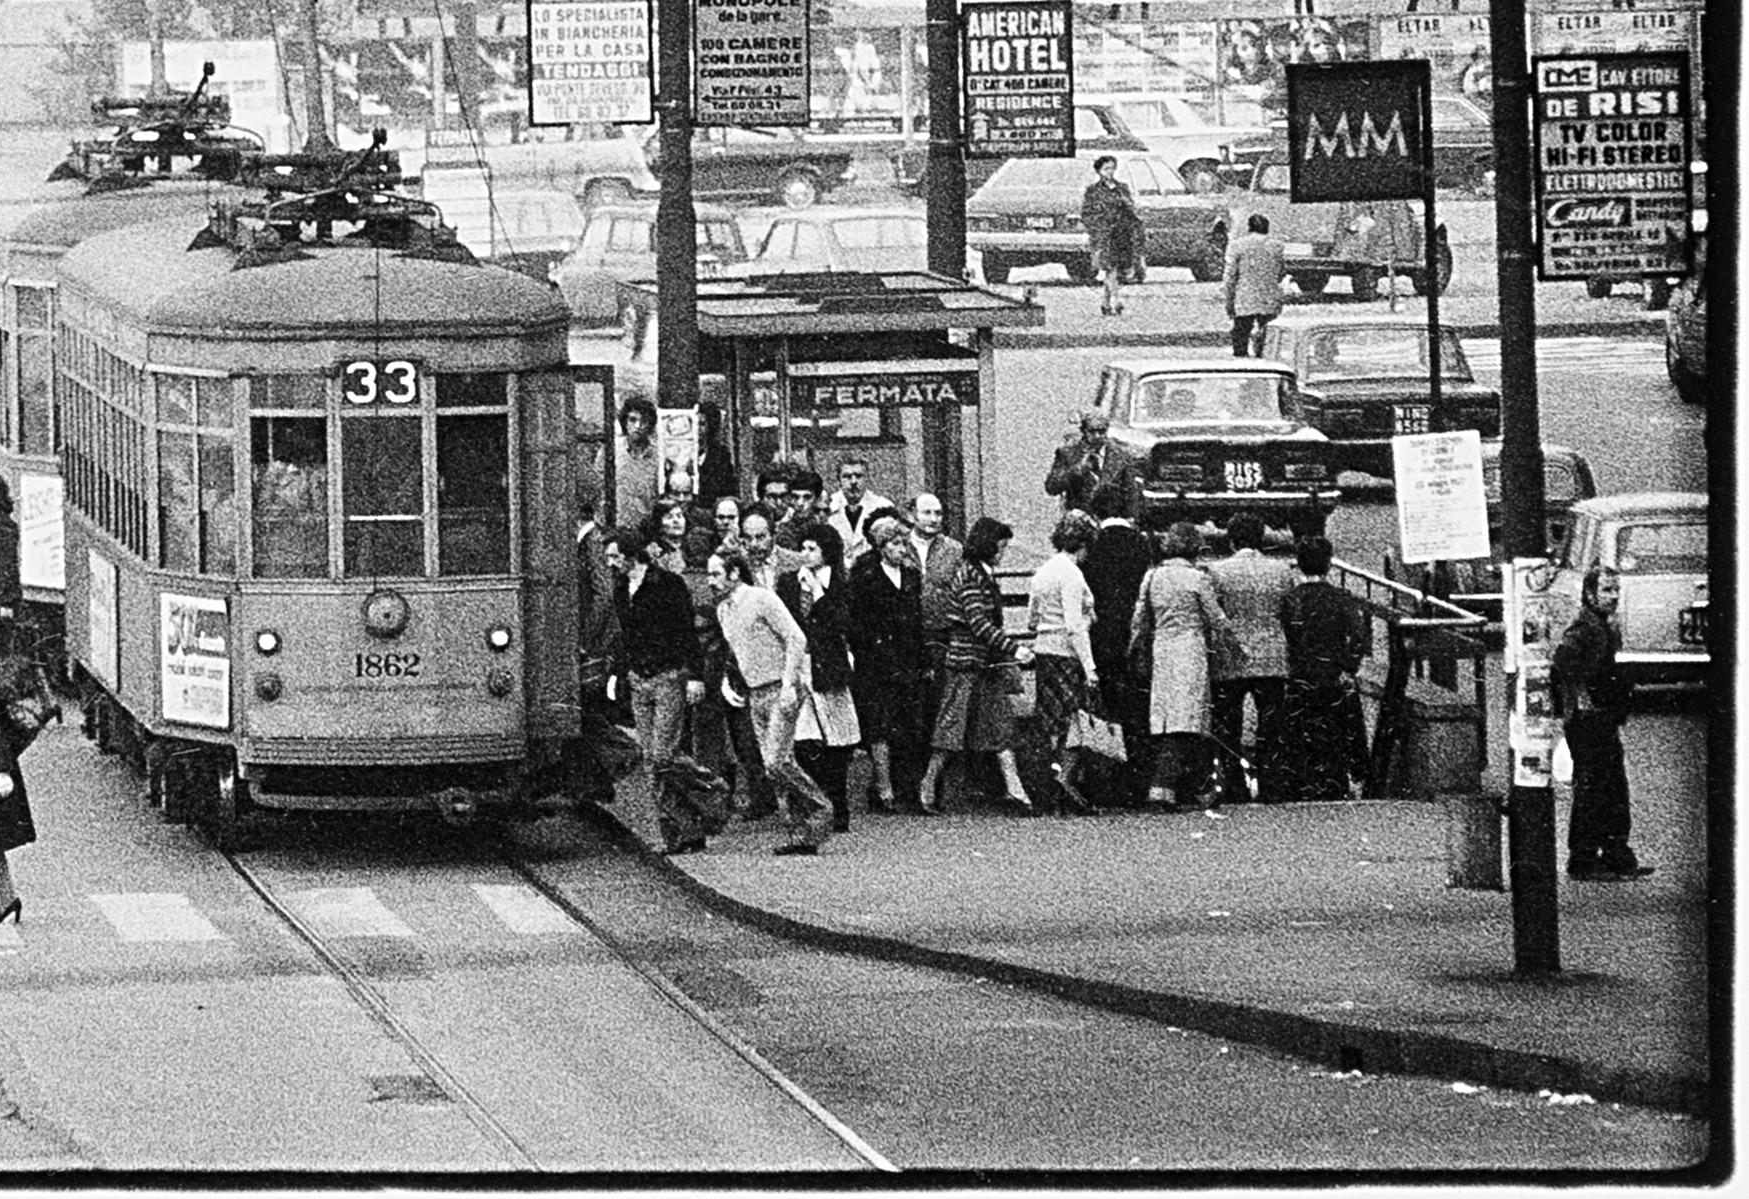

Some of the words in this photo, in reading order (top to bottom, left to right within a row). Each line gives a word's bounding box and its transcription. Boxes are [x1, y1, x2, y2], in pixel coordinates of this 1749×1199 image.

[534, 9, 550, 23] LO
[556, 6, 644, 23] SPECIALISTA
[718, 10, 734, 23] de
[736, 10, 747, 22] la
[967, 9, 1065, 38] AMERICAN
[534, 28, 549, 41] IN
[557, 25, 645, 41] BIANCHERIA
[728, 37, 802, 51] CAMERE
[535, 44, 565, 59] PER
[574, 43, 593, 58] LA
[602, 42, 645, 58] CASA
[700, 53, 730, 65] CON
[734, 52, 790, 65] BAGNO
[969, 37, 1067, 73] HOTEL
[975, 95, 1063, 111] RESIDENCE
[1546, 98, 1578, 117] DE
[1589, 90, 1679, 116] RISI
[1303, 109, 1409, 161] MM
[1559, 122, 1588, 144] TV
[1596, 120, 1667, 143] COLOR
[1546, 146, 1597, 166] HI-FI
[1602, 144, 1681, 165] STEREO
[1546, 198, 1625, 227] Candy
[344, 361, 418, 404] 33
[815, 382, 958, 406] FERMATA
[353, 652, 421, 679] 1862
